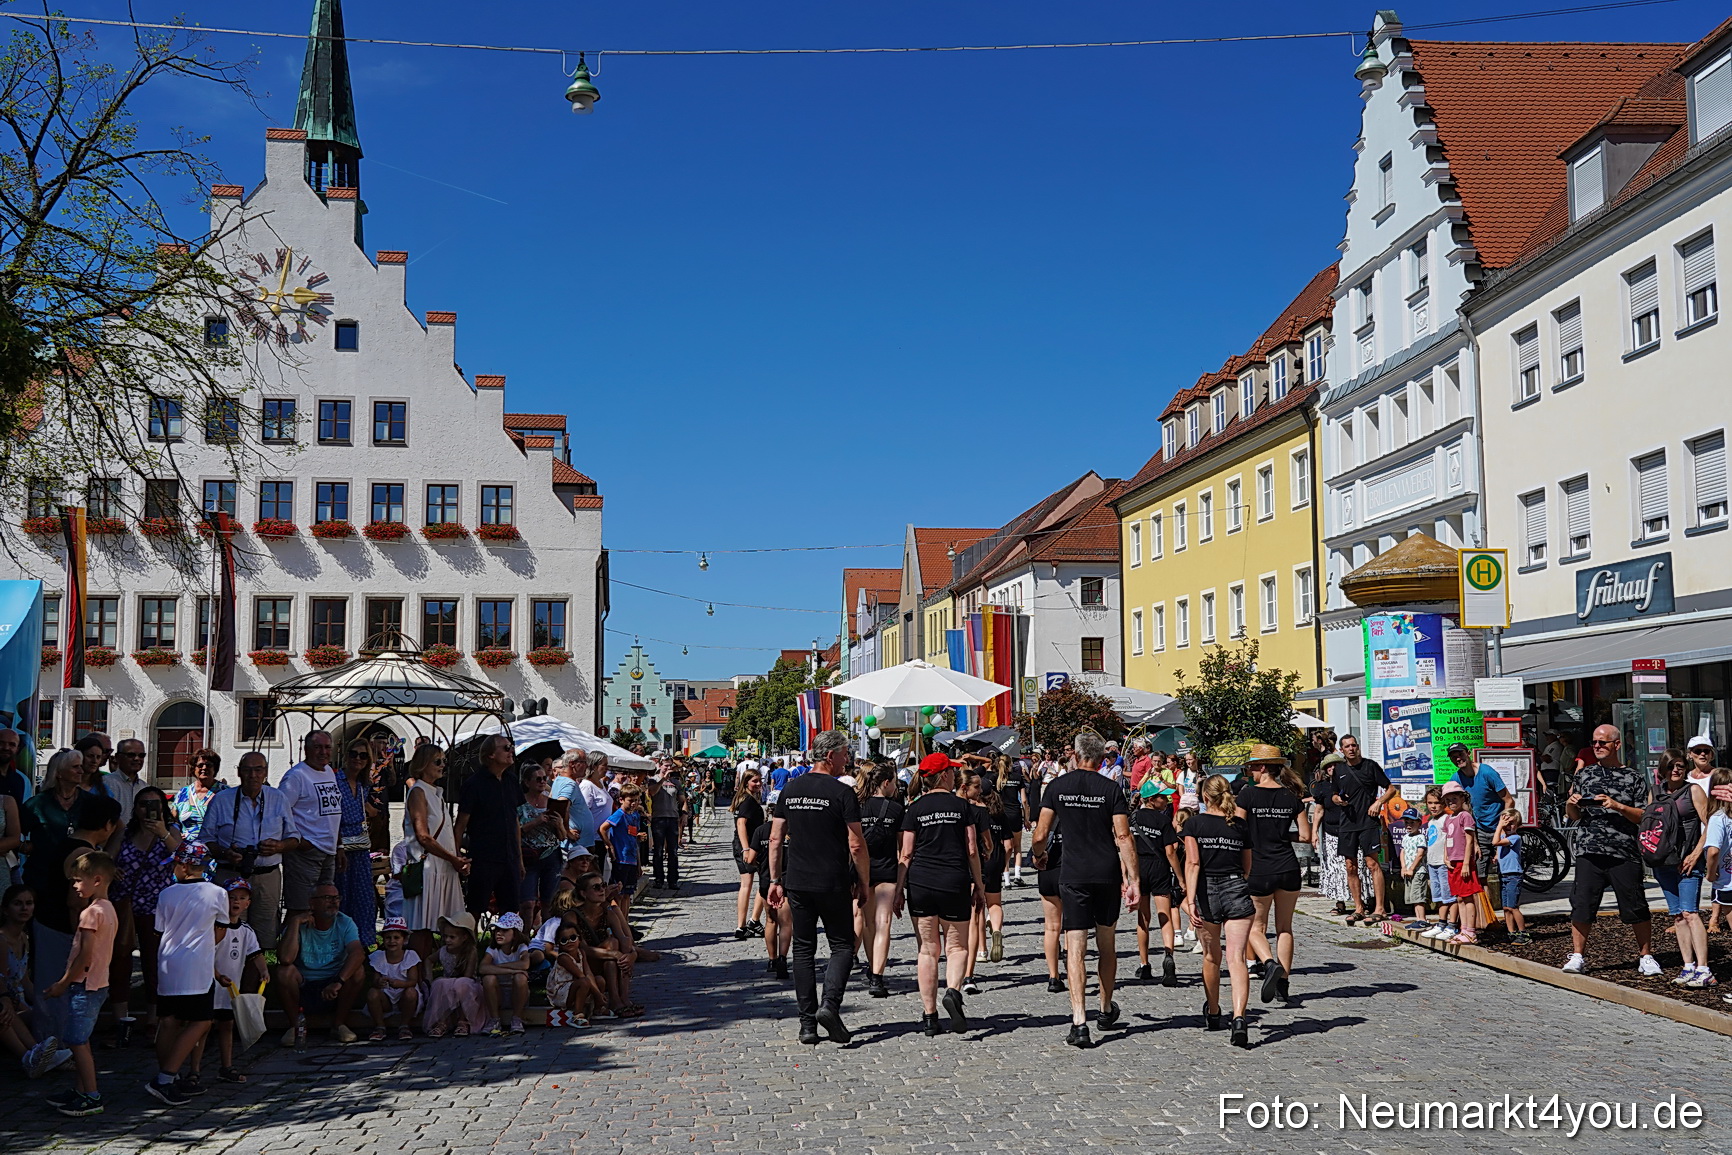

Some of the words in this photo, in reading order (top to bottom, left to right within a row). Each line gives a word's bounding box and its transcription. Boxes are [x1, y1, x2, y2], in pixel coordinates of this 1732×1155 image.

[1369, 482, 1400, 510] BRILLEN
[1402, 468, 1434, 497] WEBER
[1477, 563, 1491, 582] H
[1578, 562, 1664, 618] frühauf
[1433, 726, 1483, 734] VOLKSFEST
[785, 797, 802, 805] FUNNY
[803, 797, 829, 806] ROLLERS
[1081, 794, 1105, 803] ROLLERS
[1219, 837, 1244, 846] ROLLERS
